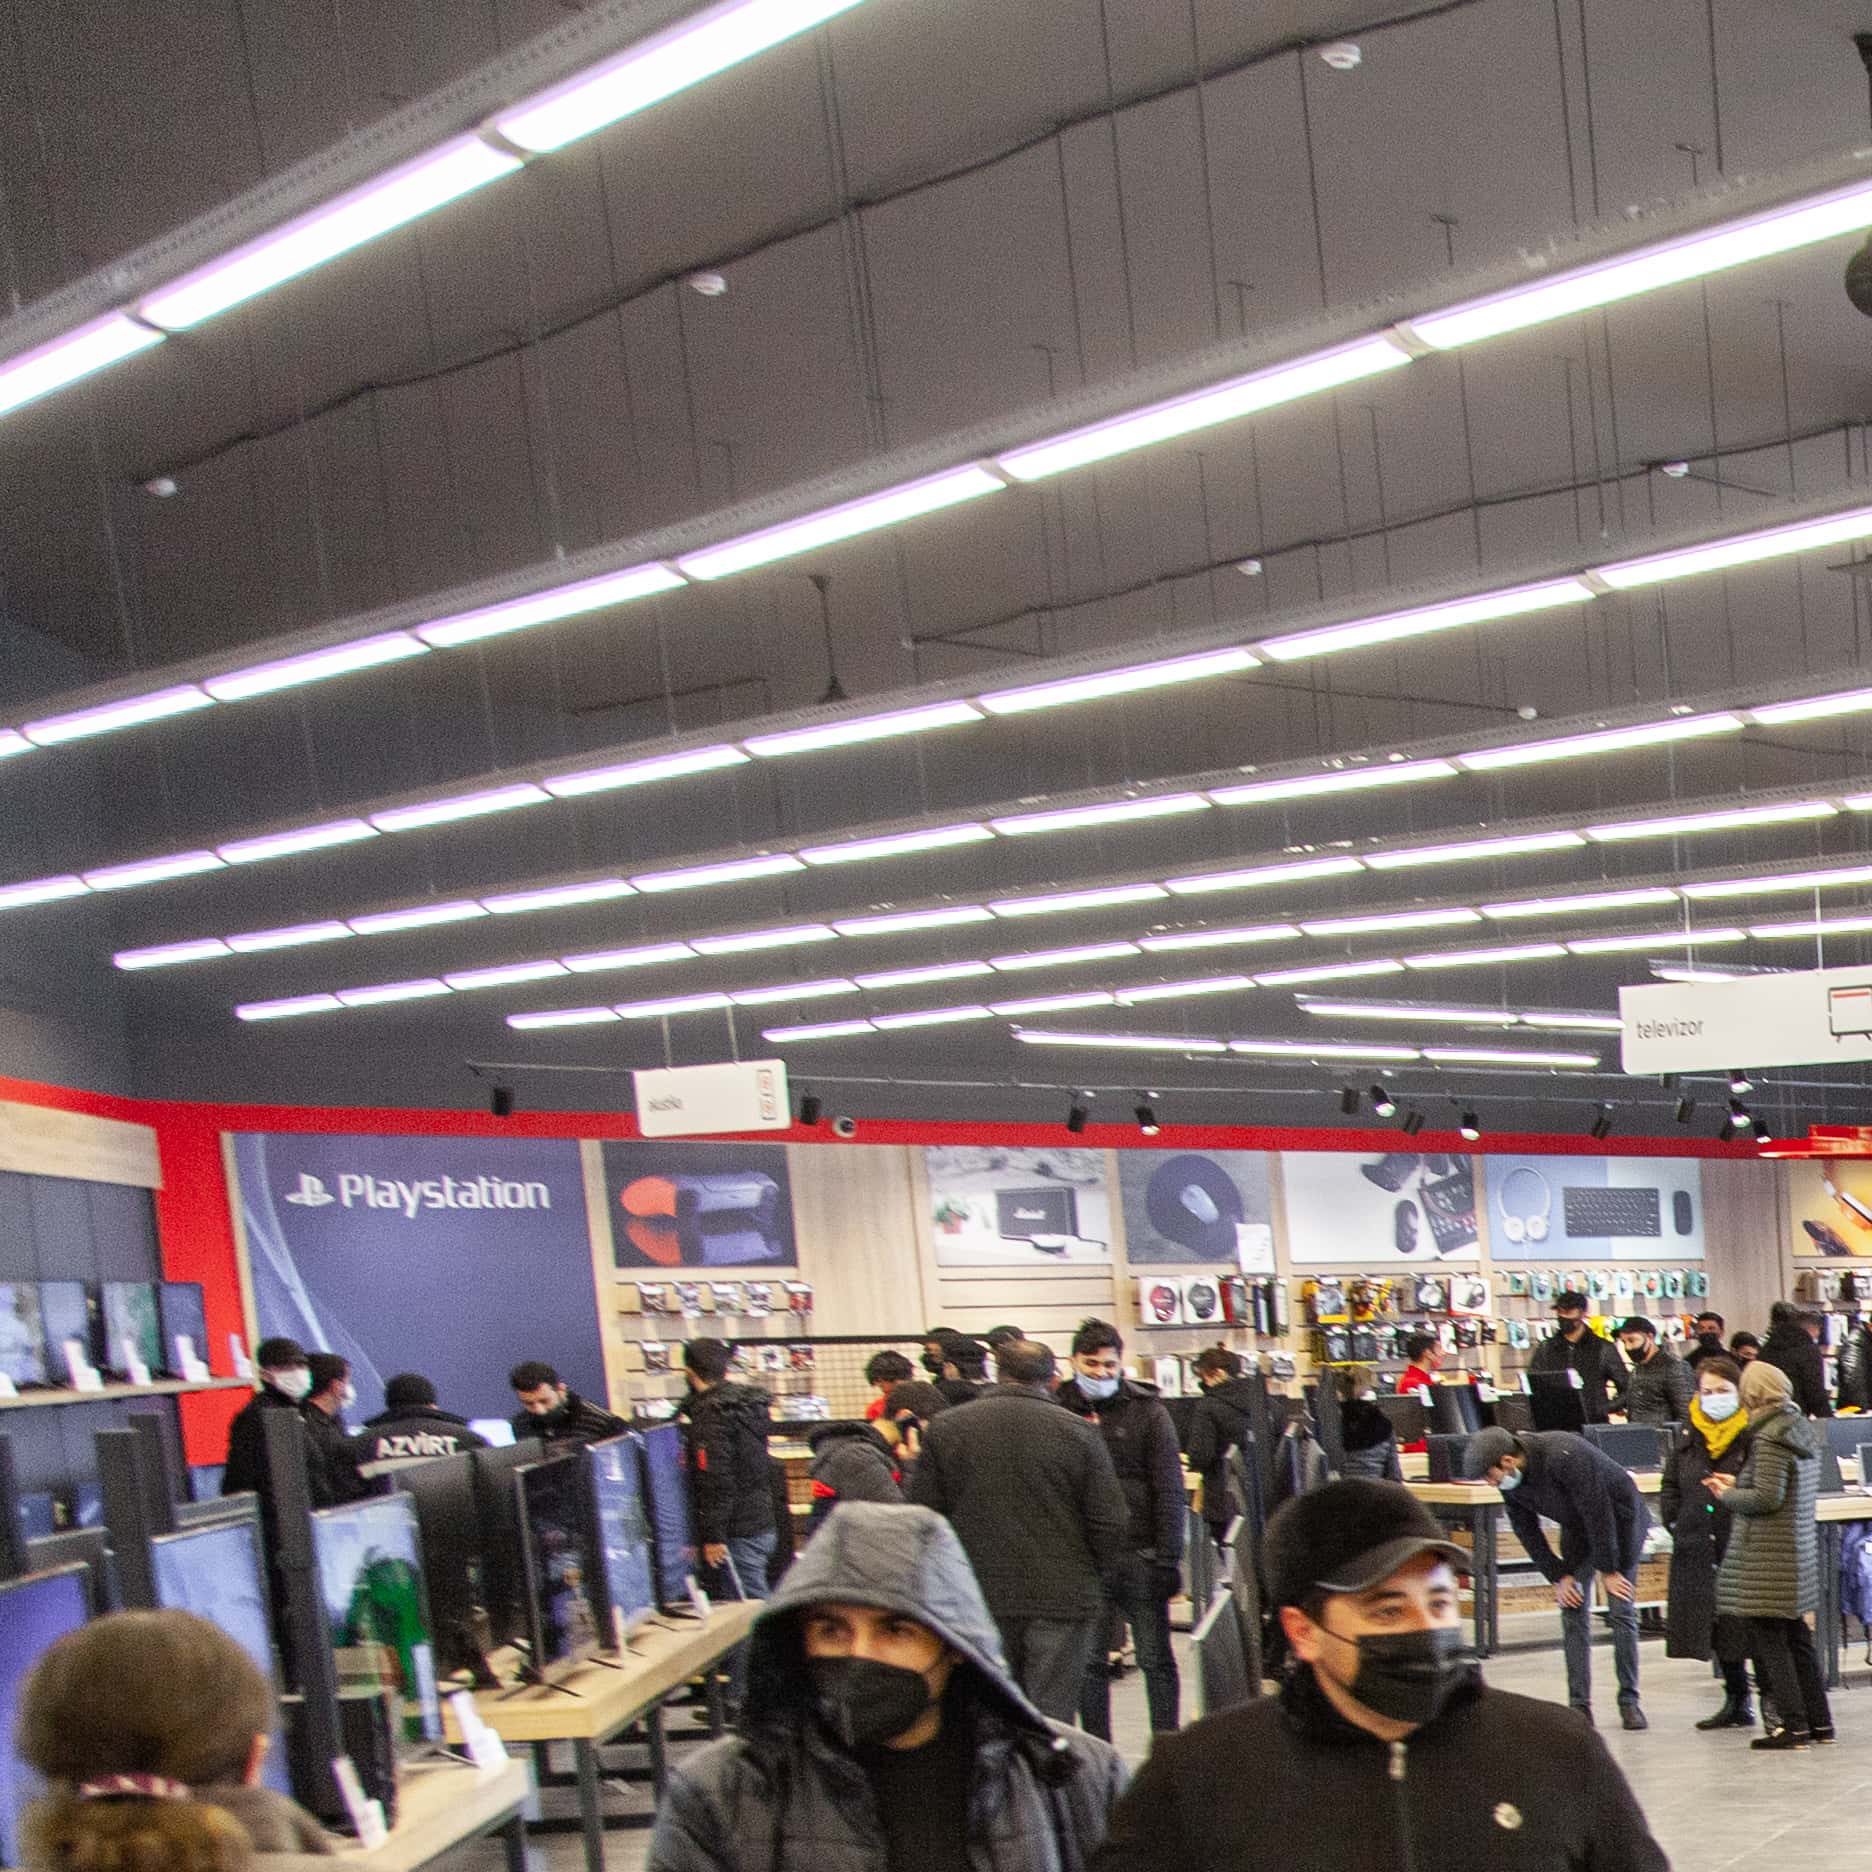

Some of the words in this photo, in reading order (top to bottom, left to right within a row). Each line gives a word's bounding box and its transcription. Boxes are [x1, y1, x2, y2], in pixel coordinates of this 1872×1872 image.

[1636, 1017, 1704, 1040] televizor
[338, 1173, 551, 1219] Playstation
[377, 1430, 459, 1458] AZVİRT
